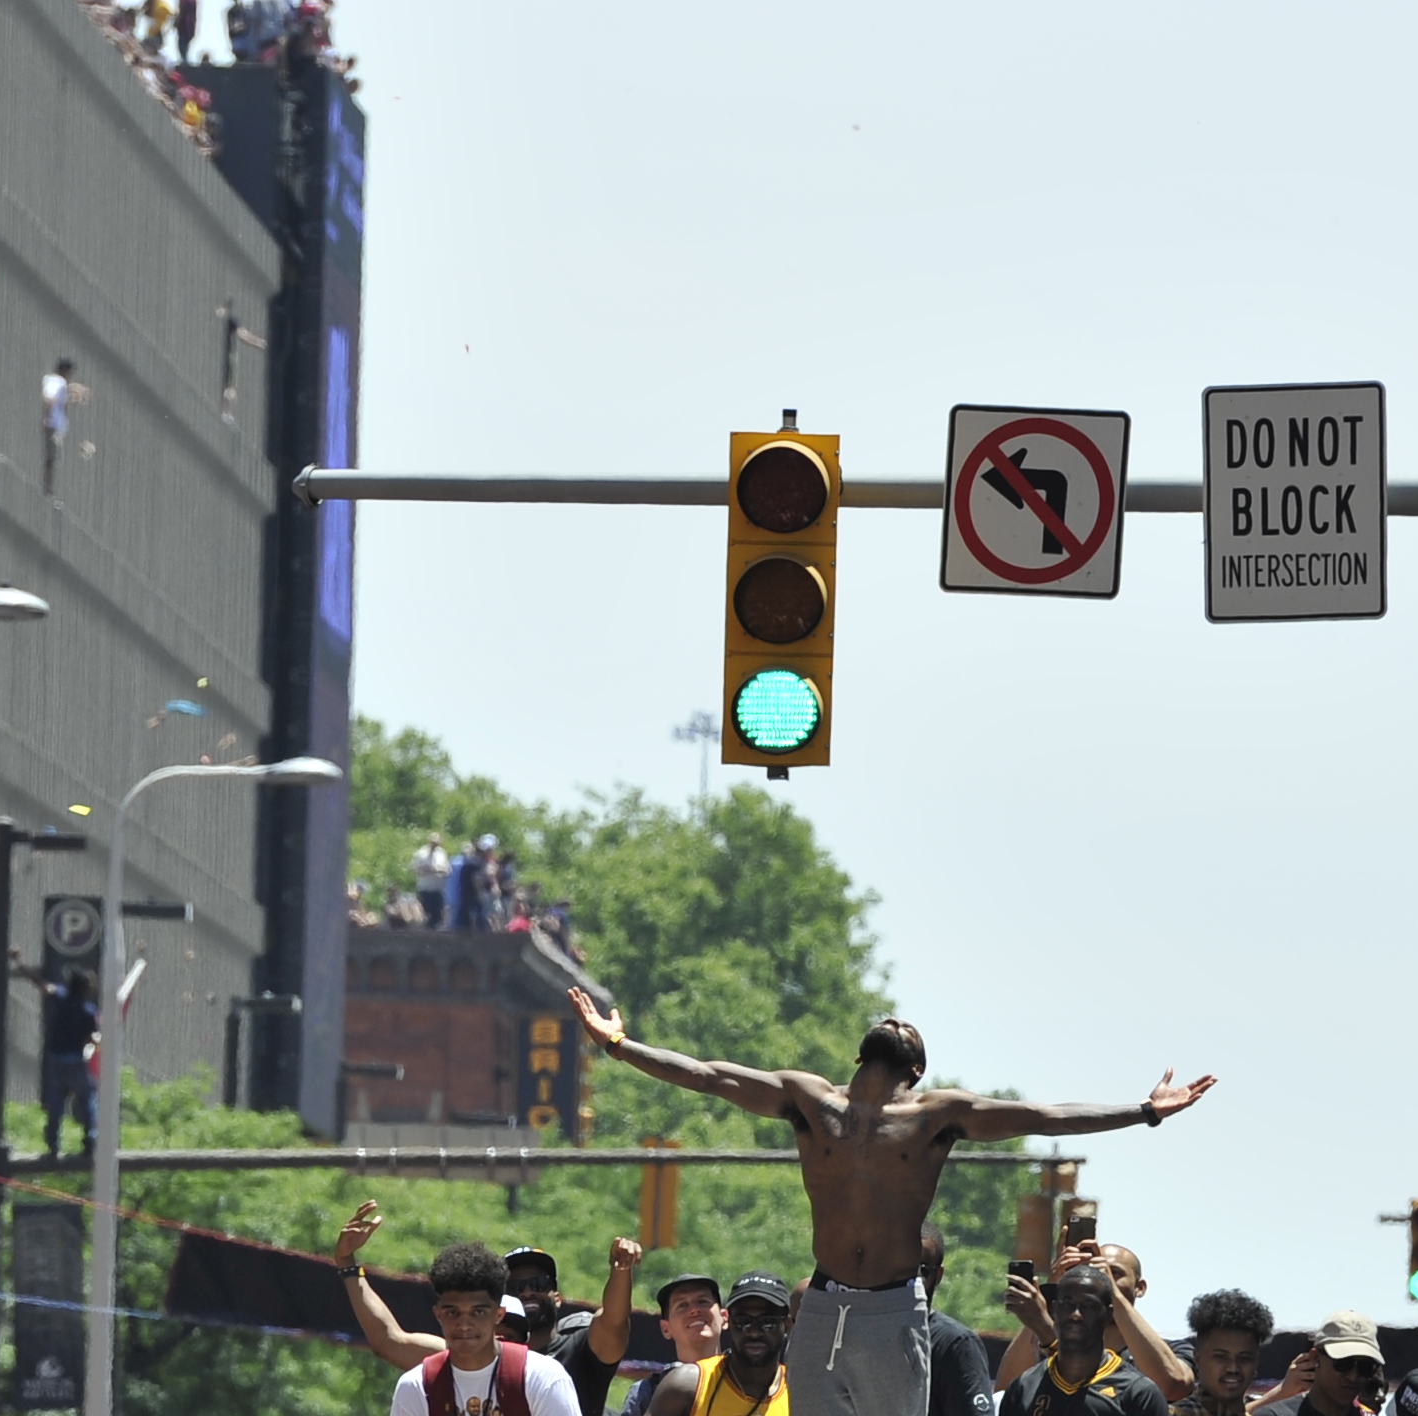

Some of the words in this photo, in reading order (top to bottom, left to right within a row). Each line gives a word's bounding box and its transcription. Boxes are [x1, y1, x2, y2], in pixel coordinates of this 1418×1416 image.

[1227, 416, 1275, 469] DO
[1289, 415, 1364, 468] NOT
[1231, 484, 1357, 538] BLOCK
[1221, 552, 1368, 590] INTERSECTION
